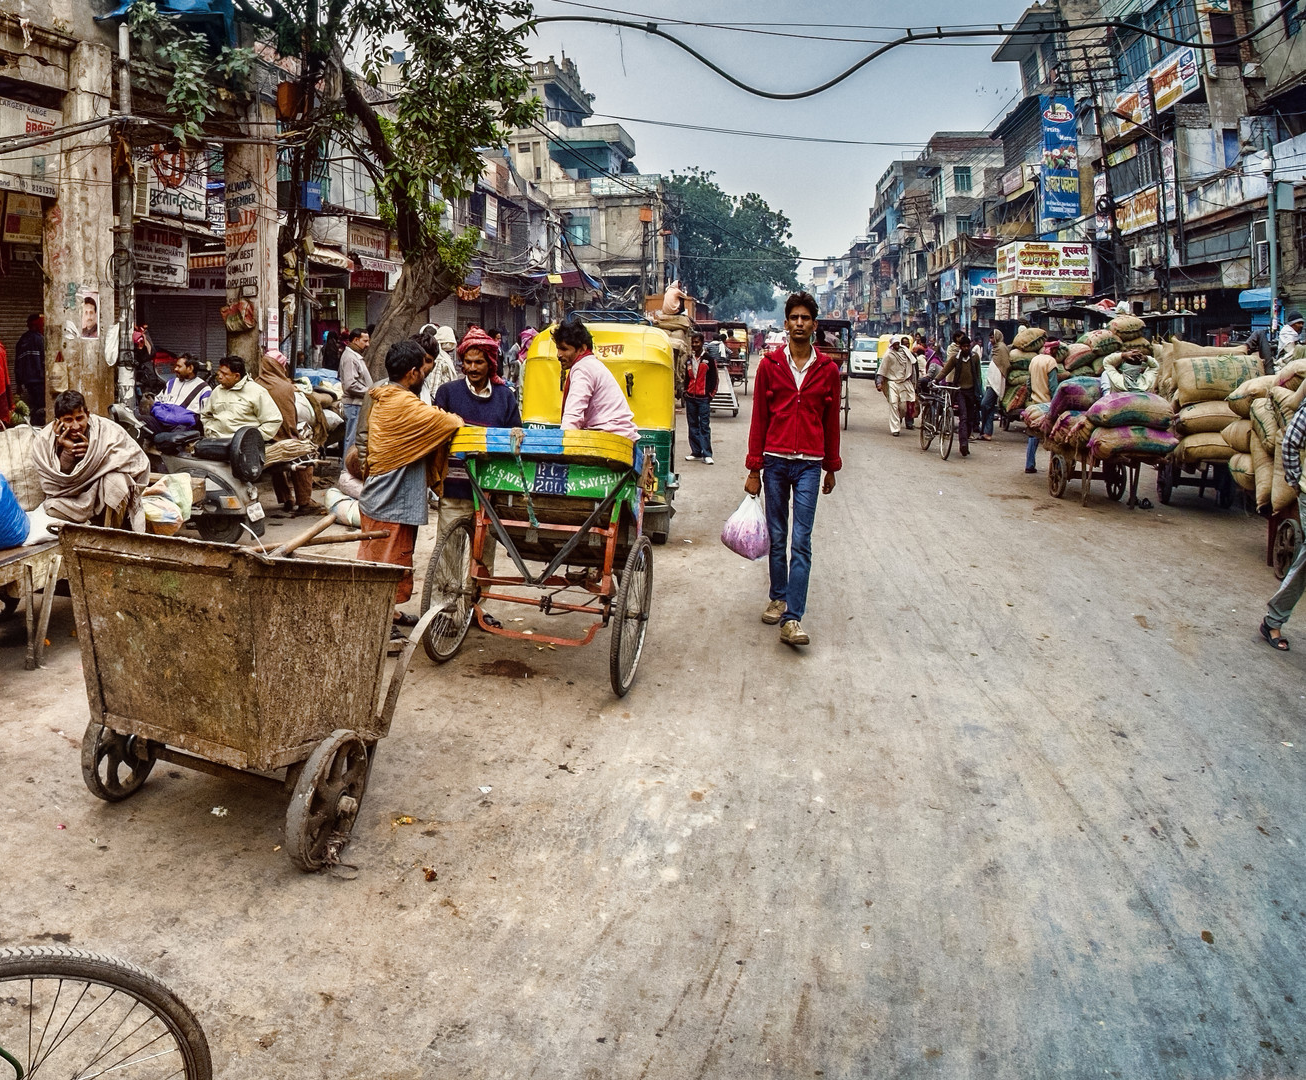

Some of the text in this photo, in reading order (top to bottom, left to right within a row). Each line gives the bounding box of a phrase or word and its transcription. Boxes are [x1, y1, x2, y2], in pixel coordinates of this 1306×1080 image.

[27, 105, 48, 117] RANGE
[226, 180, 252, 194] ALWAYS
[226, 229, 258, 248] STORES
[239, 249, 255, 260] BEST
[227, 262, 254, 276] QUALITY
